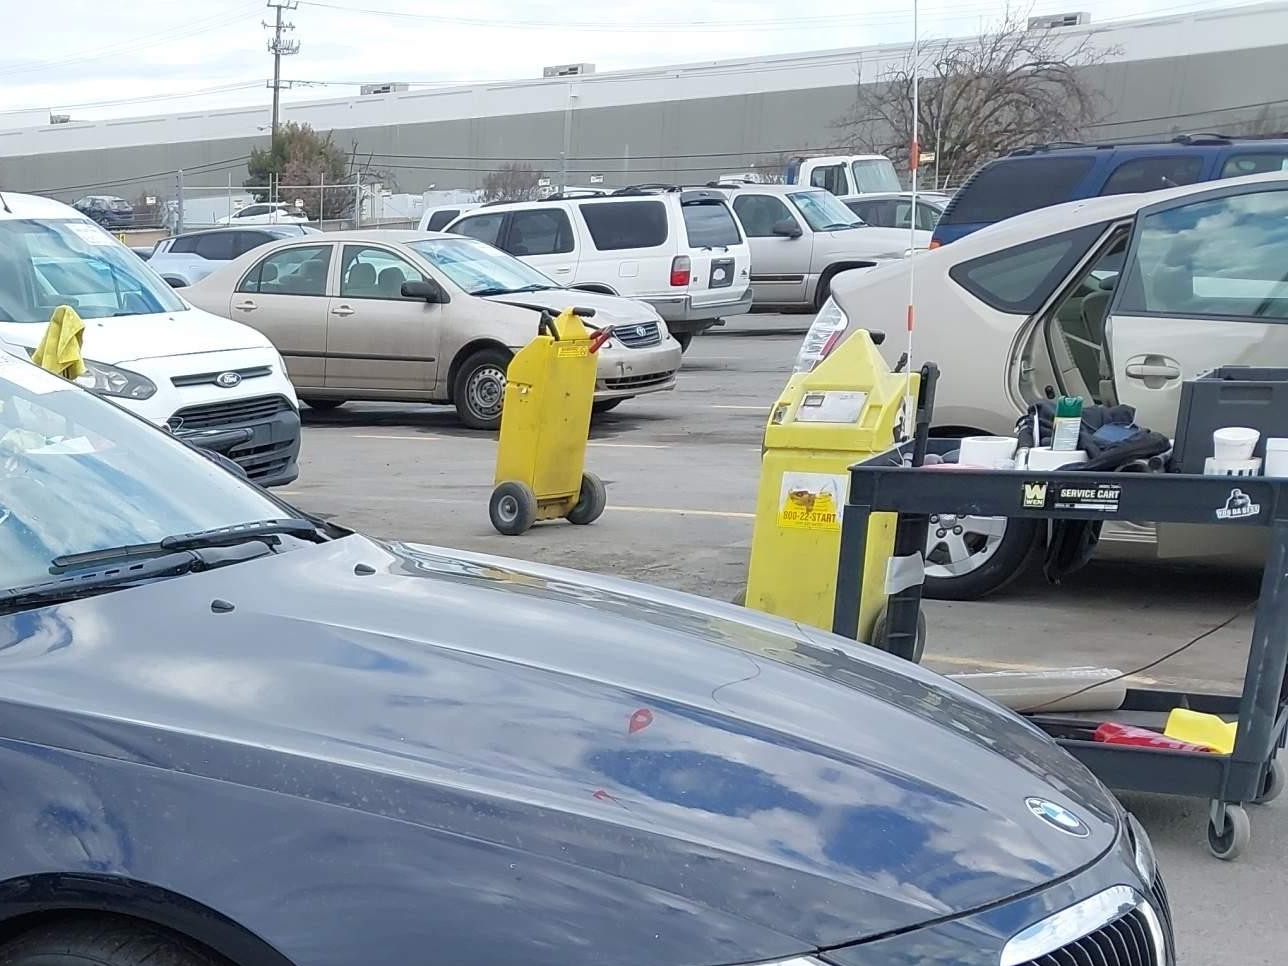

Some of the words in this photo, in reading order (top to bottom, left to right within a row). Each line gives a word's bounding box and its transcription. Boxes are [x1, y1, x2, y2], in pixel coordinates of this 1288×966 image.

[1060, 488, 1096, 499] SERVICE
[1096, 489, 1121, 500] CART
[783, 510, 836, 523] 800-22-START
